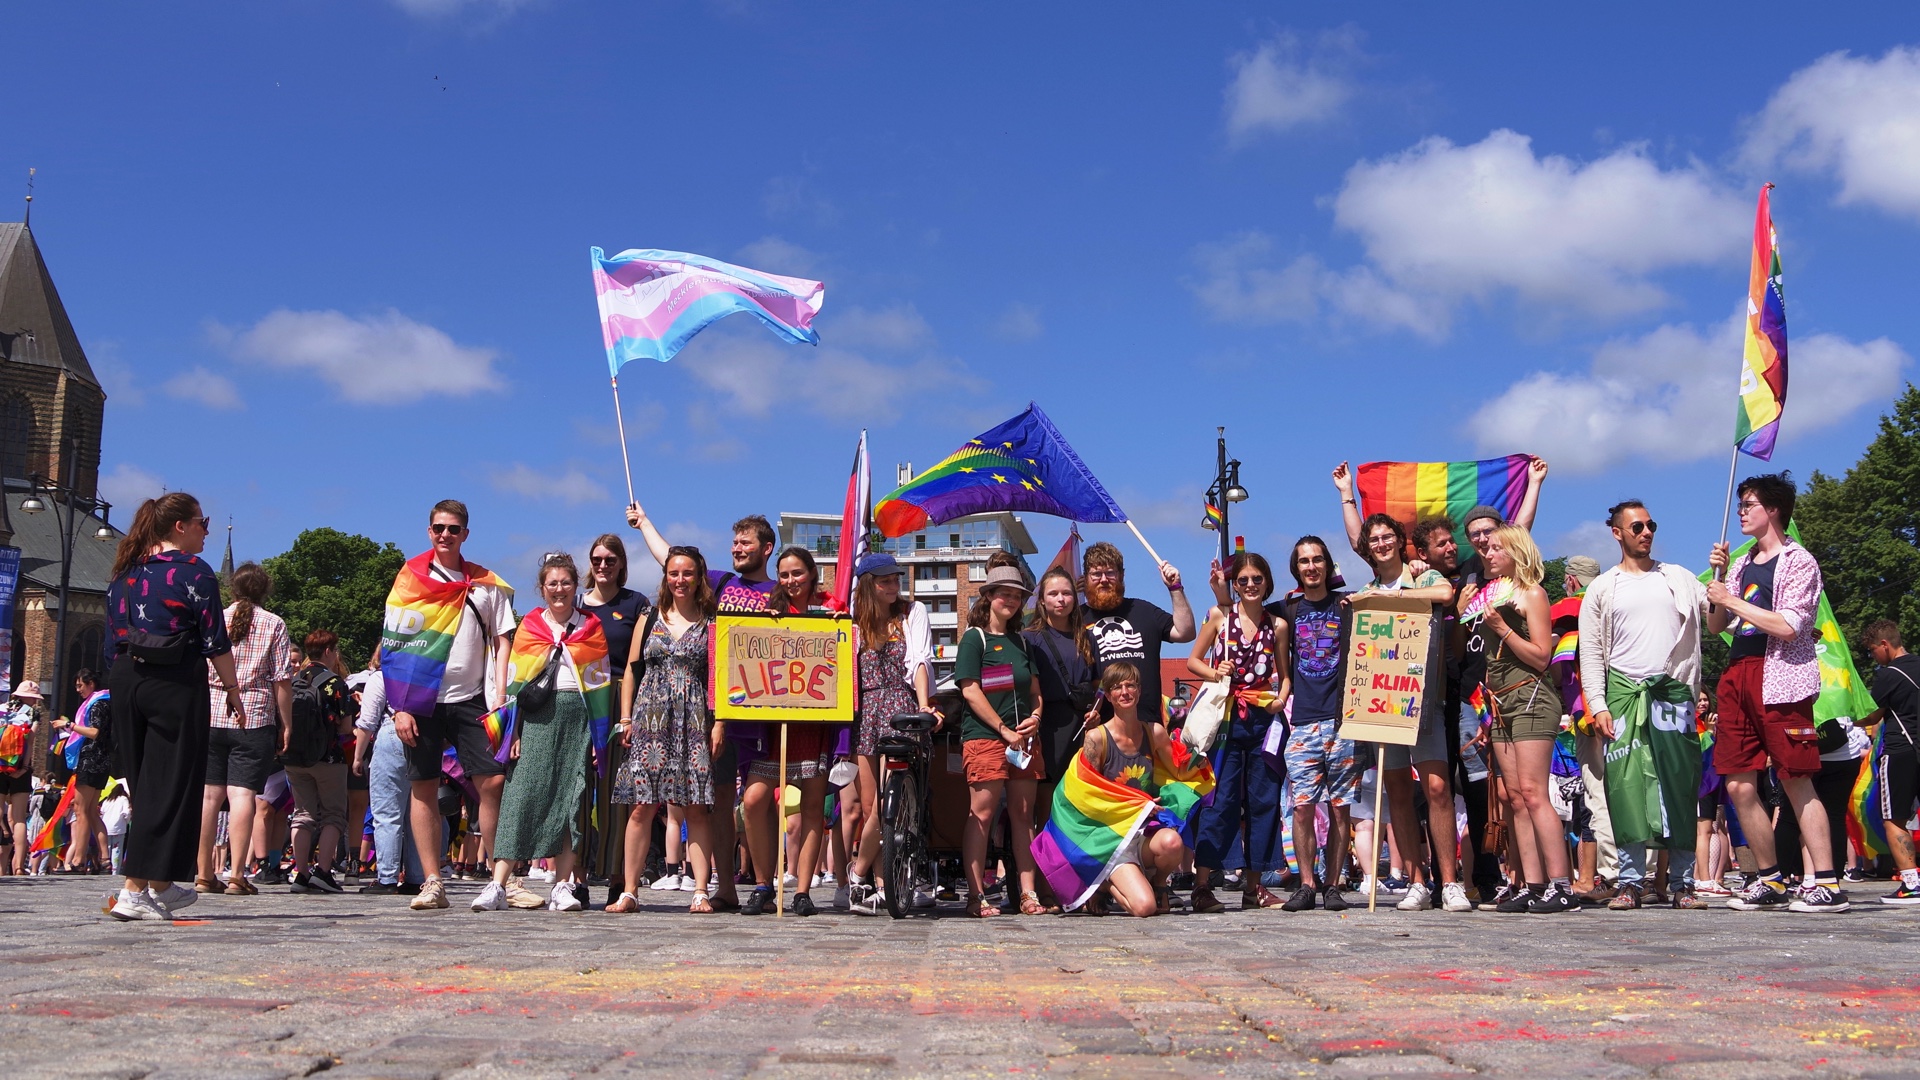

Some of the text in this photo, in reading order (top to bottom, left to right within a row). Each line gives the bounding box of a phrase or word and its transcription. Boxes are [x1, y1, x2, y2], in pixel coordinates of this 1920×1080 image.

[1356, 613, 1421, 640] Egal wie
[733, 632, 837, 661] HAUPTSACHE
[1355, 641, 1417, 660] Schwul du
[738, 660, 834, 700] LIEBE
[1351, 673, 1421, 693] das KLIMA
[1351, 693, 1361, 707] ist
